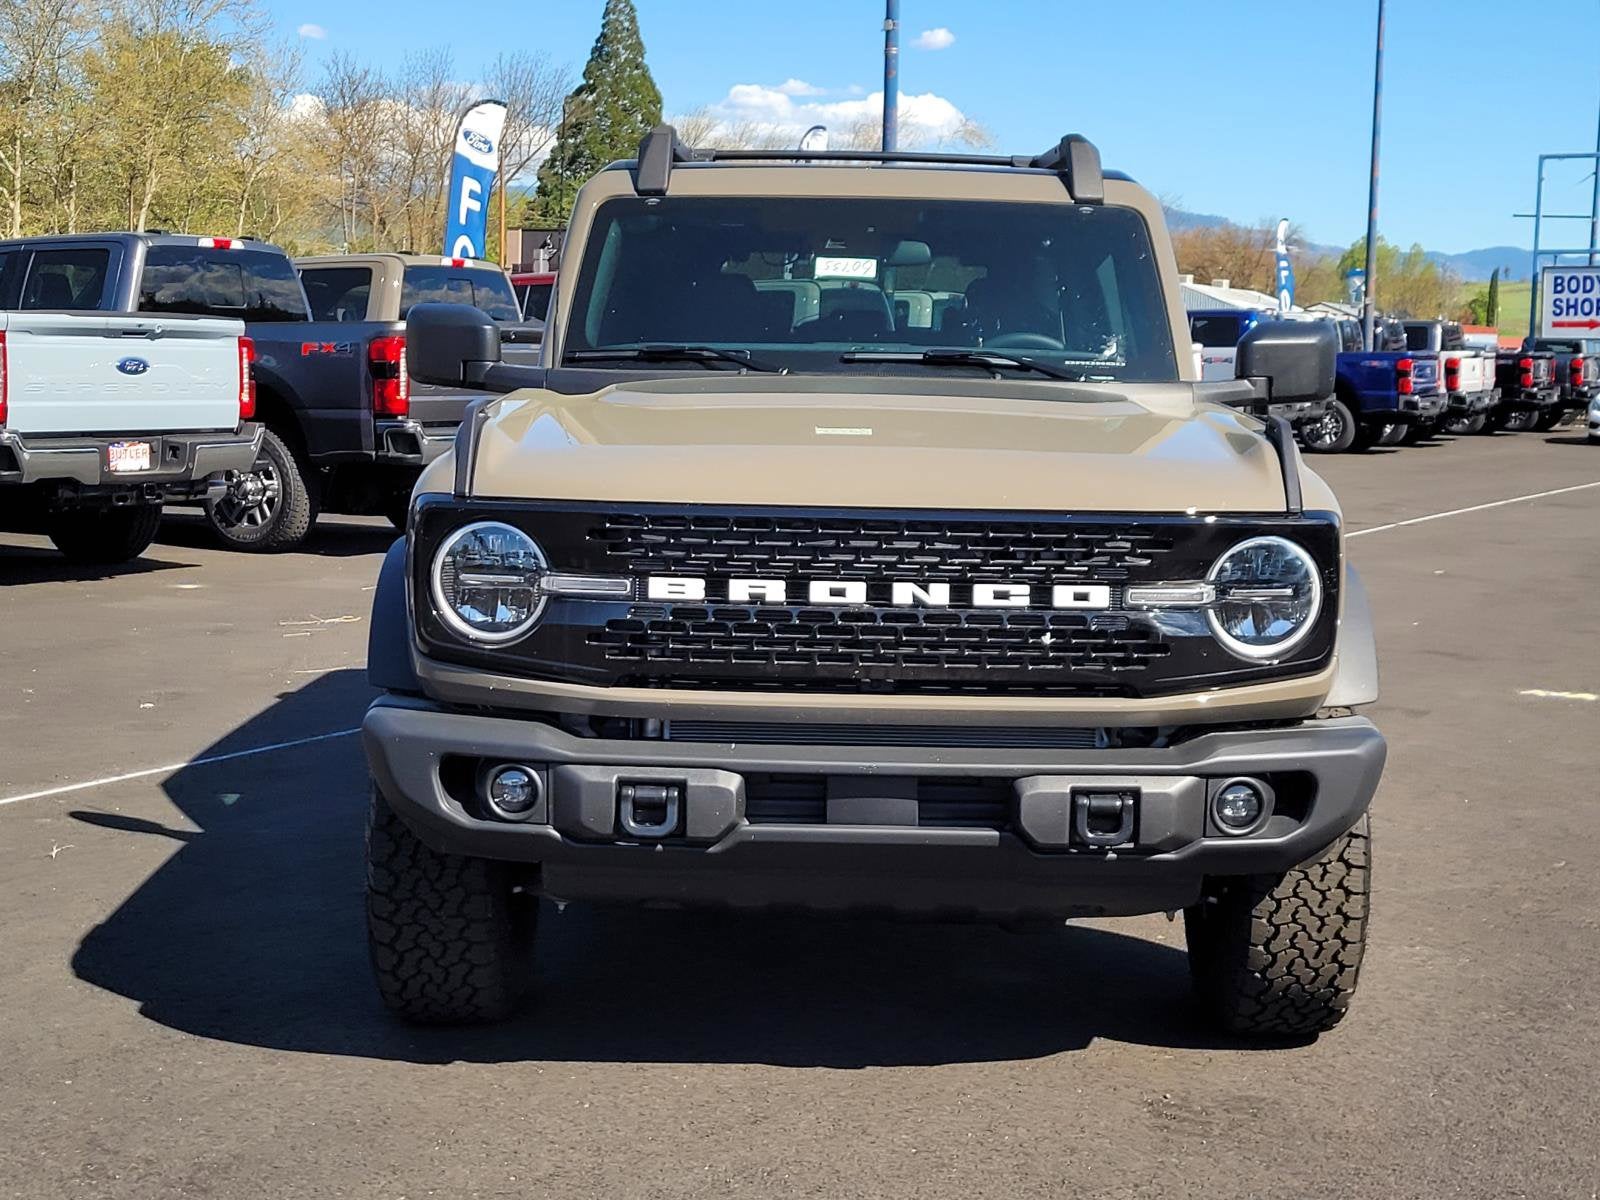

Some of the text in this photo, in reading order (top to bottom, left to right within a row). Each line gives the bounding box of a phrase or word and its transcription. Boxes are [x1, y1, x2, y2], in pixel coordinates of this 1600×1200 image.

[1553, 275, 1600, 294] BOD
[301, 342, 352, 356] FX4
[24, 382, 229, 394] SUPER DUTY
[648, 575, 1111, 609] BRONCO
